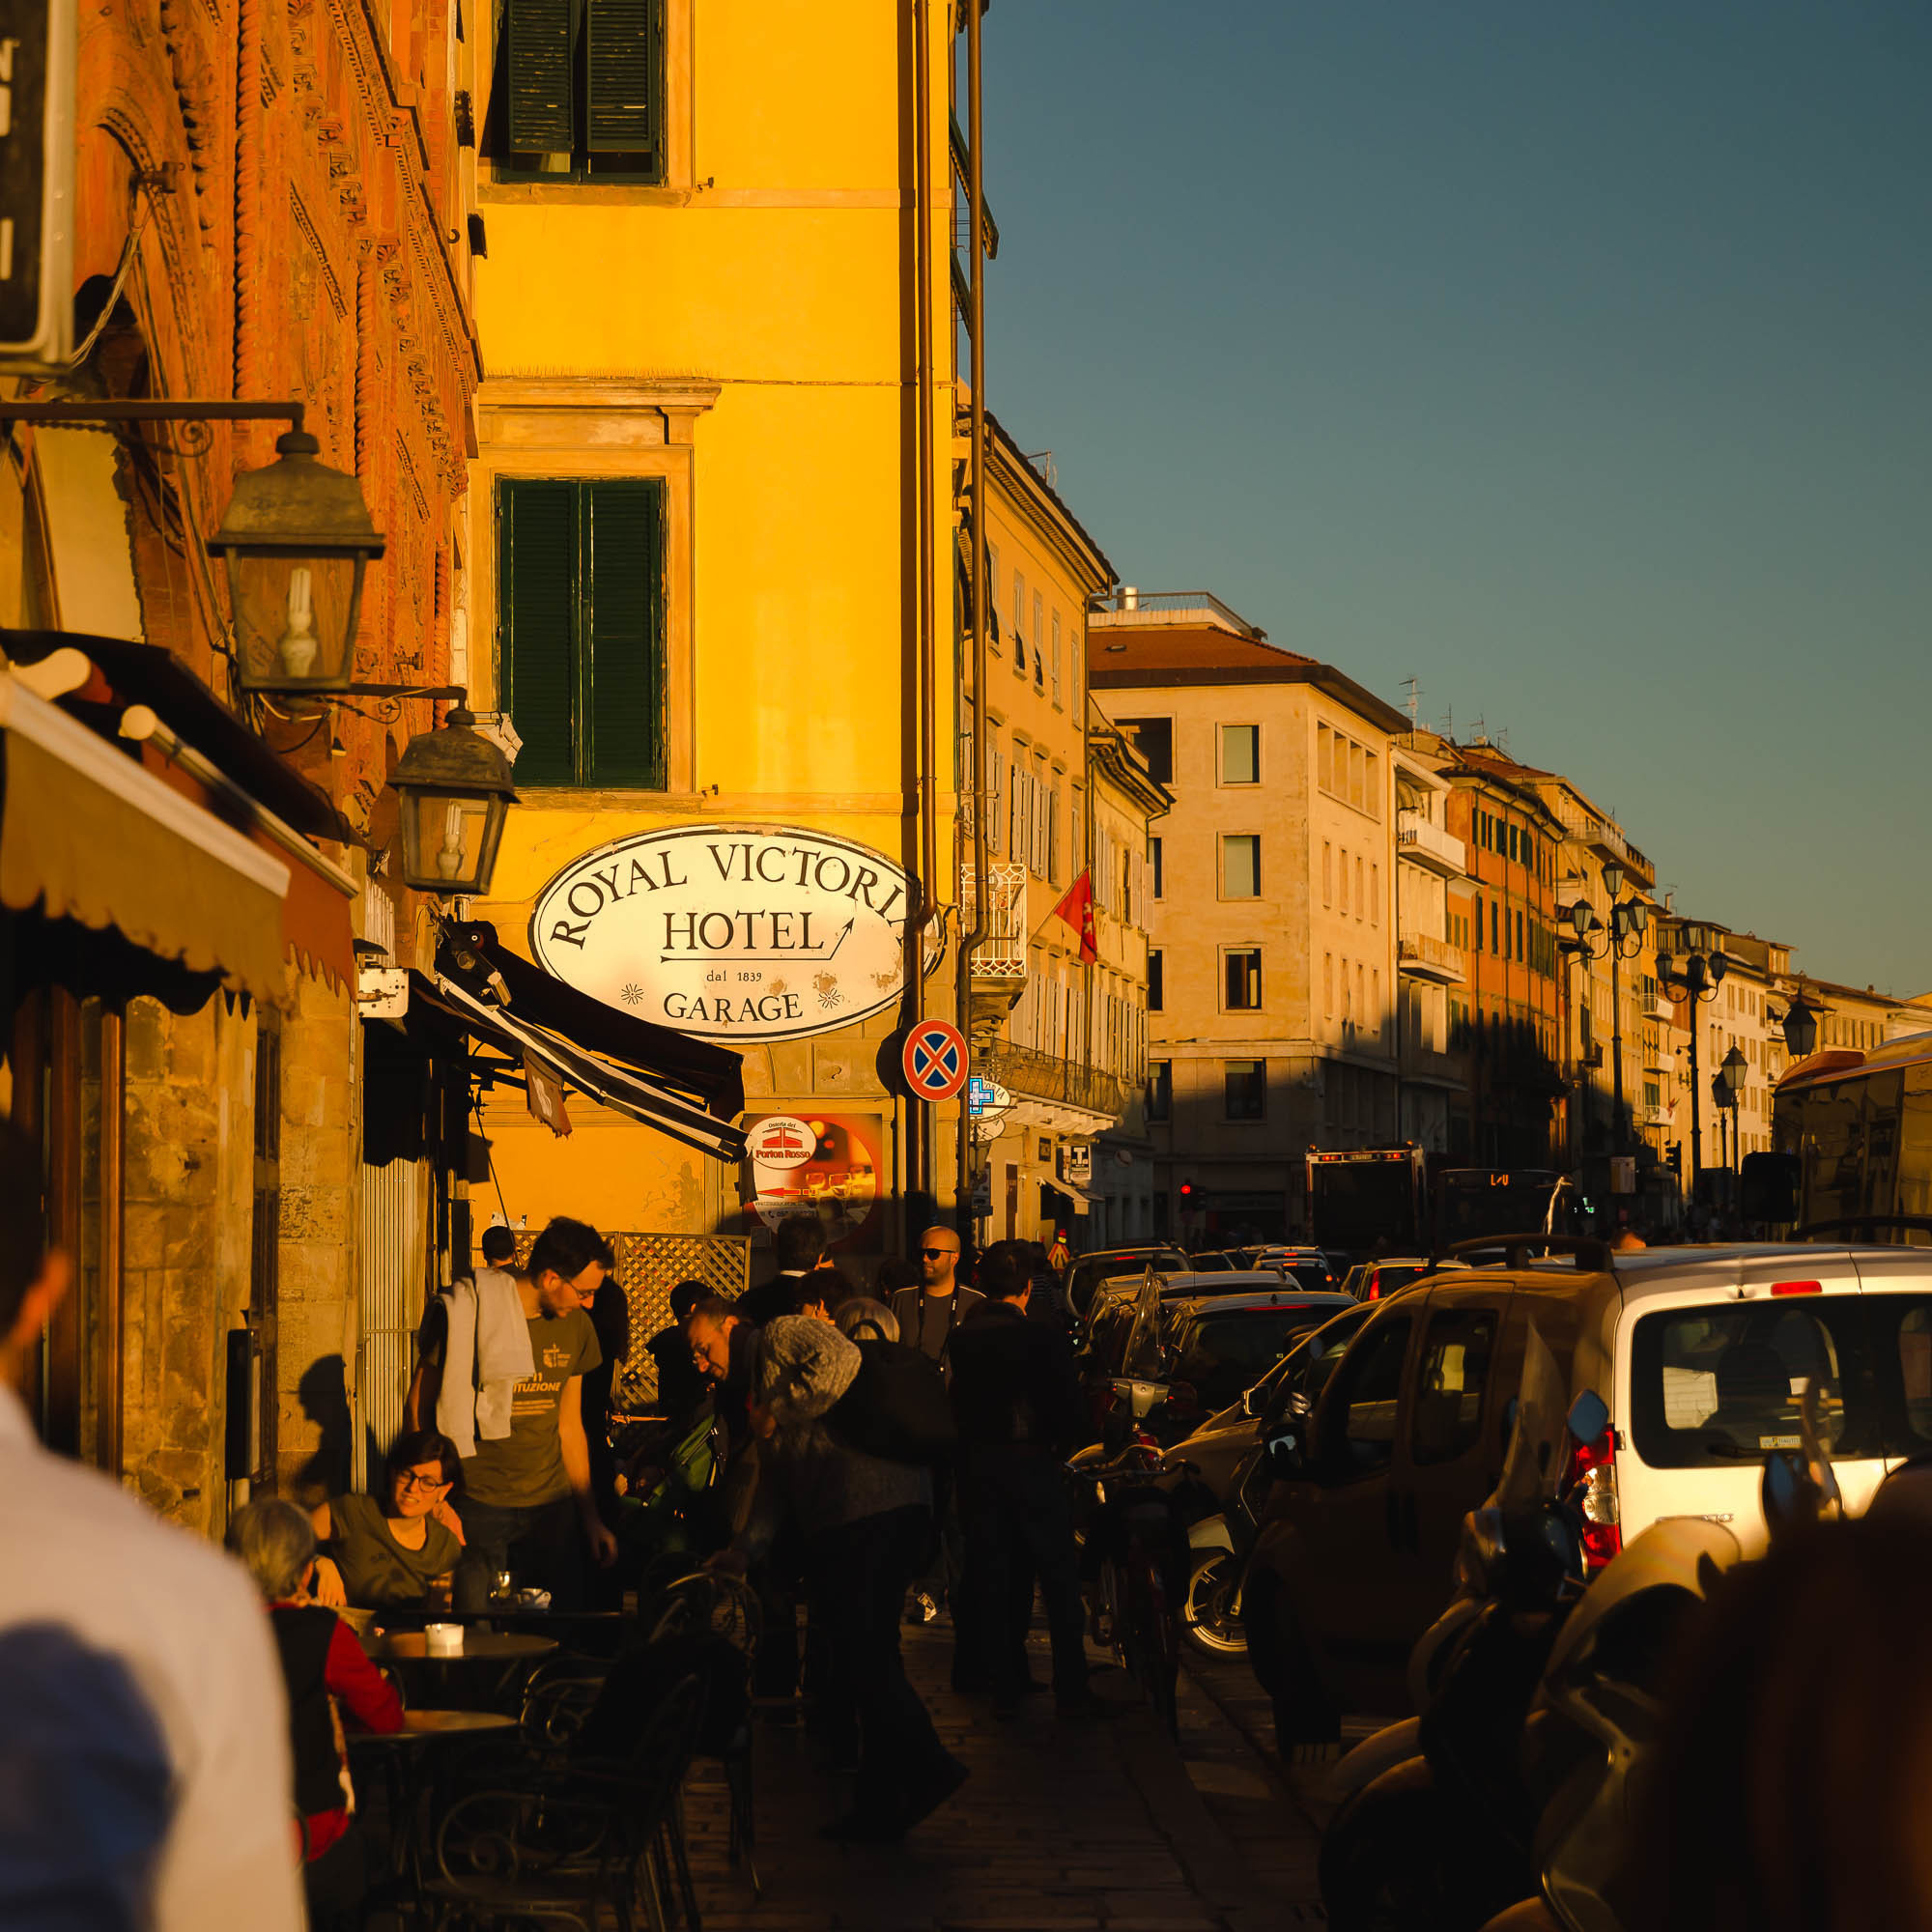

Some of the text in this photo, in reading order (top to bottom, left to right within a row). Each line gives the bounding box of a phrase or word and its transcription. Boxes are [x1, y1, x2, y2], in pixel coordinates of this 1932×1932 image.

[550, 850, 688, 951] ROYAL
[662, 909, 825, 951] HOTEL
[706, 969, 762, 982] dal 1839
[663, 992, 804, 1023] GARAGE
[755, 1150, 810, 1159] Porton Rosso
